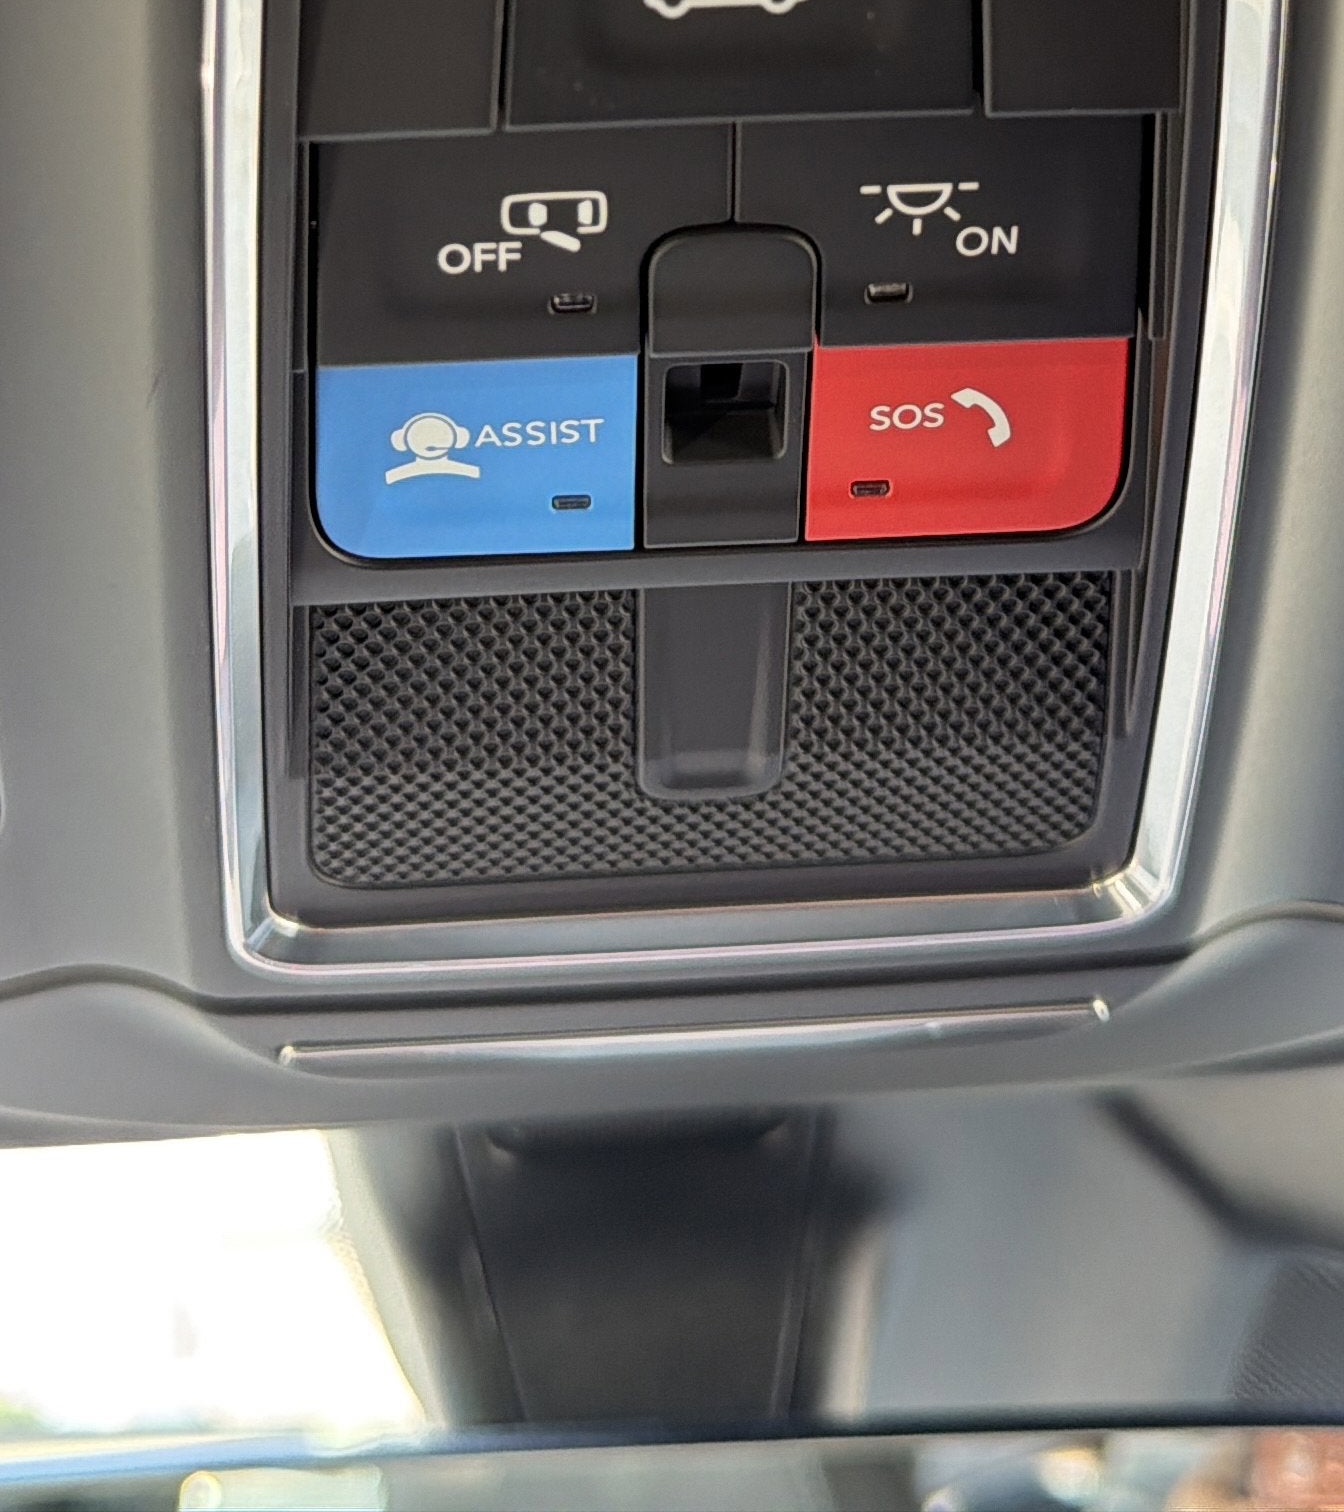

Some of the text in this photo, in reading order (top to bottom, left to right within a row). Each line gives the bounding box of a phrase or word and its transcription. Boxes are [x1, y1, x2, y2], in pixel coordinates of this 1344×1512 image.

[955, 225, 1019, 257] ON
[437, 241, 523, 274] OFF
[868, 402, 945, 431] SOS
[474, 418, 605, 448] ASSIST
